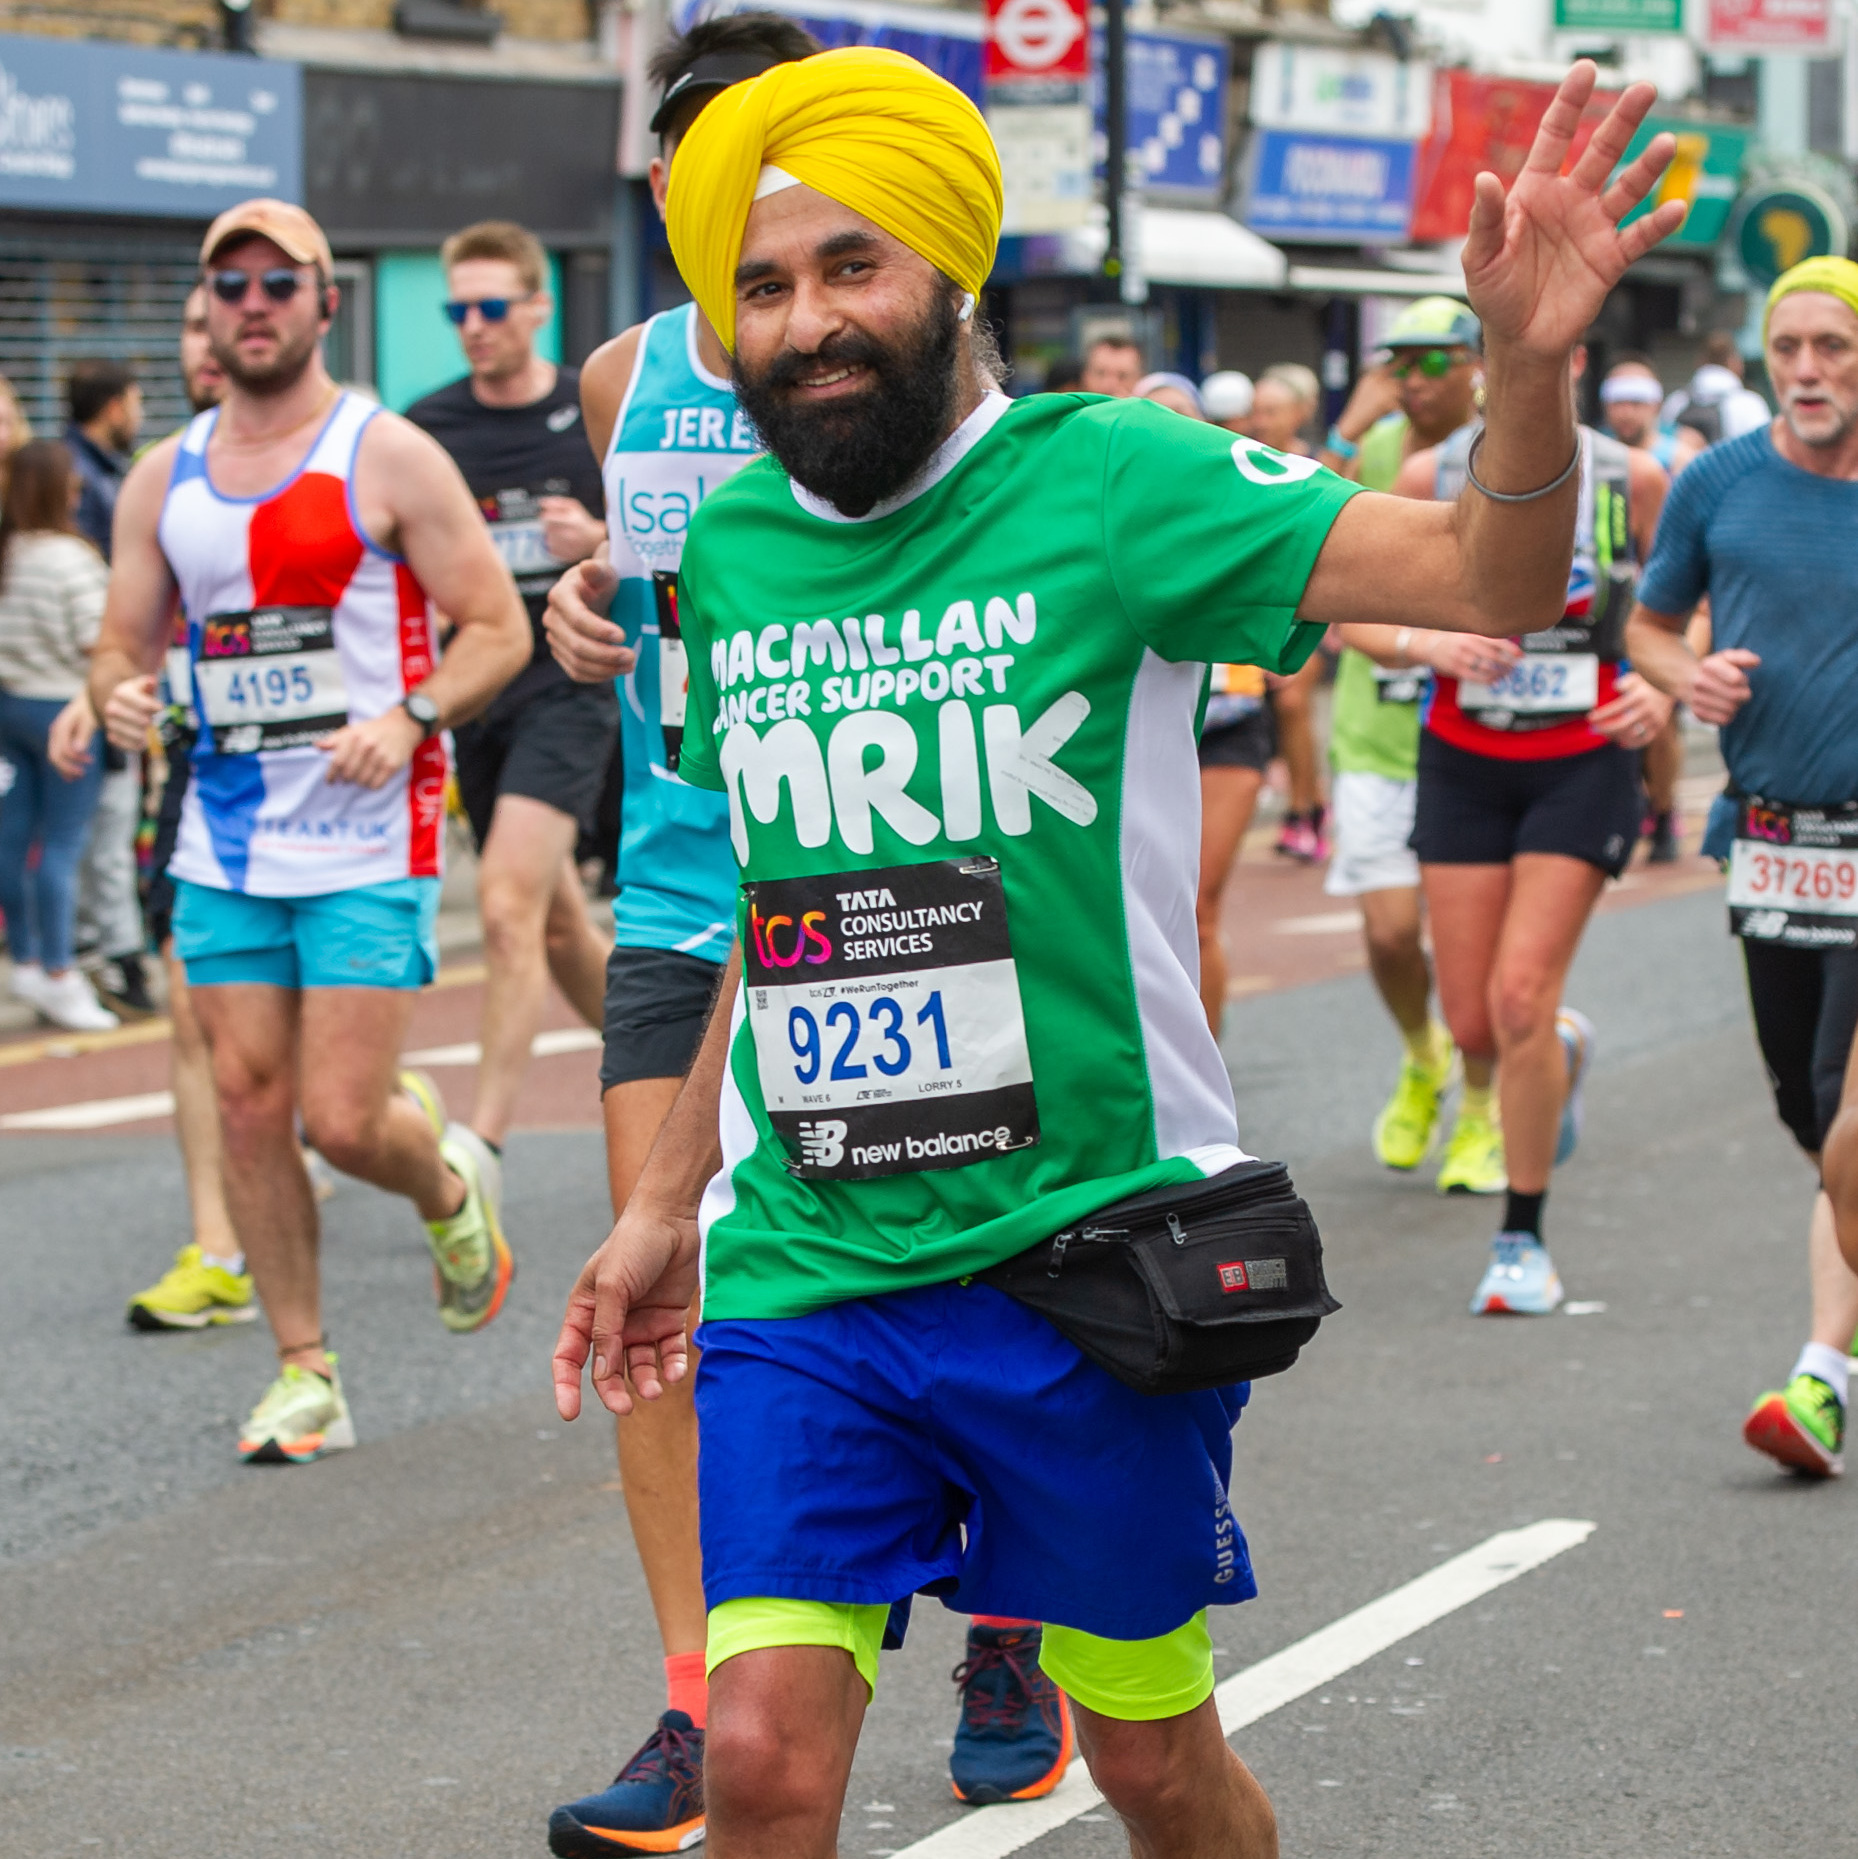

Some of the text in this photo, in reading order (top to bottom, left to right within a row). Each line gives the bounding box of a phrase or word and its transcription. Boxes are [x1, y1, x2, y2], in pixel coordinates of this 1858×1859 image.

[659, 406, 760, 450] JERE
[711, 592, 1037, 691] MACMILLAN
[228, 665, 314, 707] 4195
[820, 654, 1015, 714] SUPPORT
[719, 690, 1098, 868] MRIK
[1750, 854, 1856, 900] 37269
[836, 888, 897, 912] TATA
[840, 901, 983, 937] CONSULTANCY
[751, 903, 832, 968] tcs
[843, 933, 933, 961] SERVICES
[840, 979, 919, 995] #WeRunTogether
[788, 990, 952, 1085] 9231
[918, 1079, 963, 1093] LORRY 5
[851, 1125, 1011, 1165] new balance
[1213, 1502, 1235, 1584] GUESS
